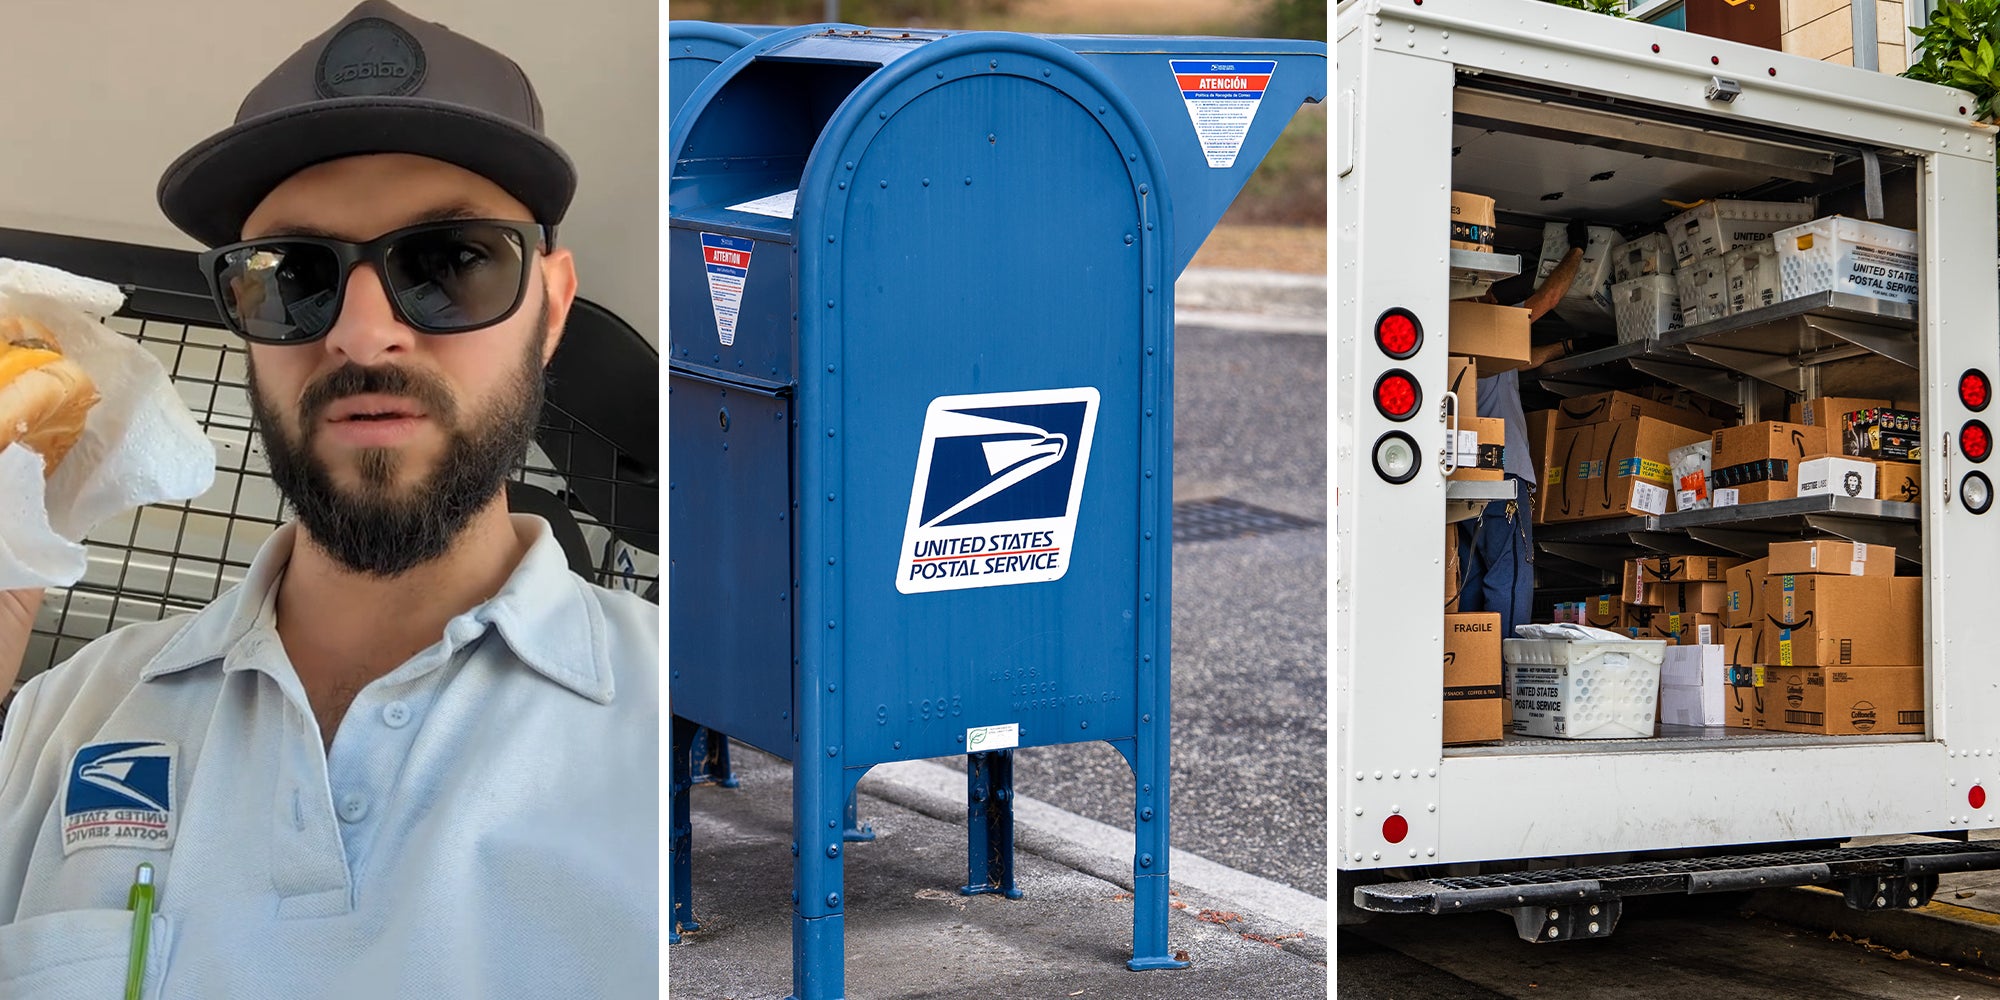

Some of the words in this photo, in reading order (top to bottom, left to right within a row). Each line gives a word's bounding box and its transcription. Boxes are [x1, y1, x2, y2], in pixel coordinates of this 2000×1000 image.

[1199, 76, 1247, 89] ATENCIÓN
[1734, 232, 1766, 241] UNITED
[713, 250, 741, 265] ATTENTION
[1853, 263, 1886, 277] UNITED
[1849, 275, 1884, 289] POSTAL
[914, 536, 986, 558] UNITED
[988, 531, 1054, 552] STATES
[910, 559, 980, 581] POSTAL
[983, 552, 1060, 575] SERVICE
[1455, 623, 1493, 632] FRAGILE
[1517, 687, 1535, 696] UNITED
[1537, 687, 1558, 697] STATES
[1515, 699, 1535, 710] POSTAL
[1536, 700, 1561, 711] SERVICE
[877, 703, 889, 726] 9
[1851, 711, 1876, 719] Cottonelle
